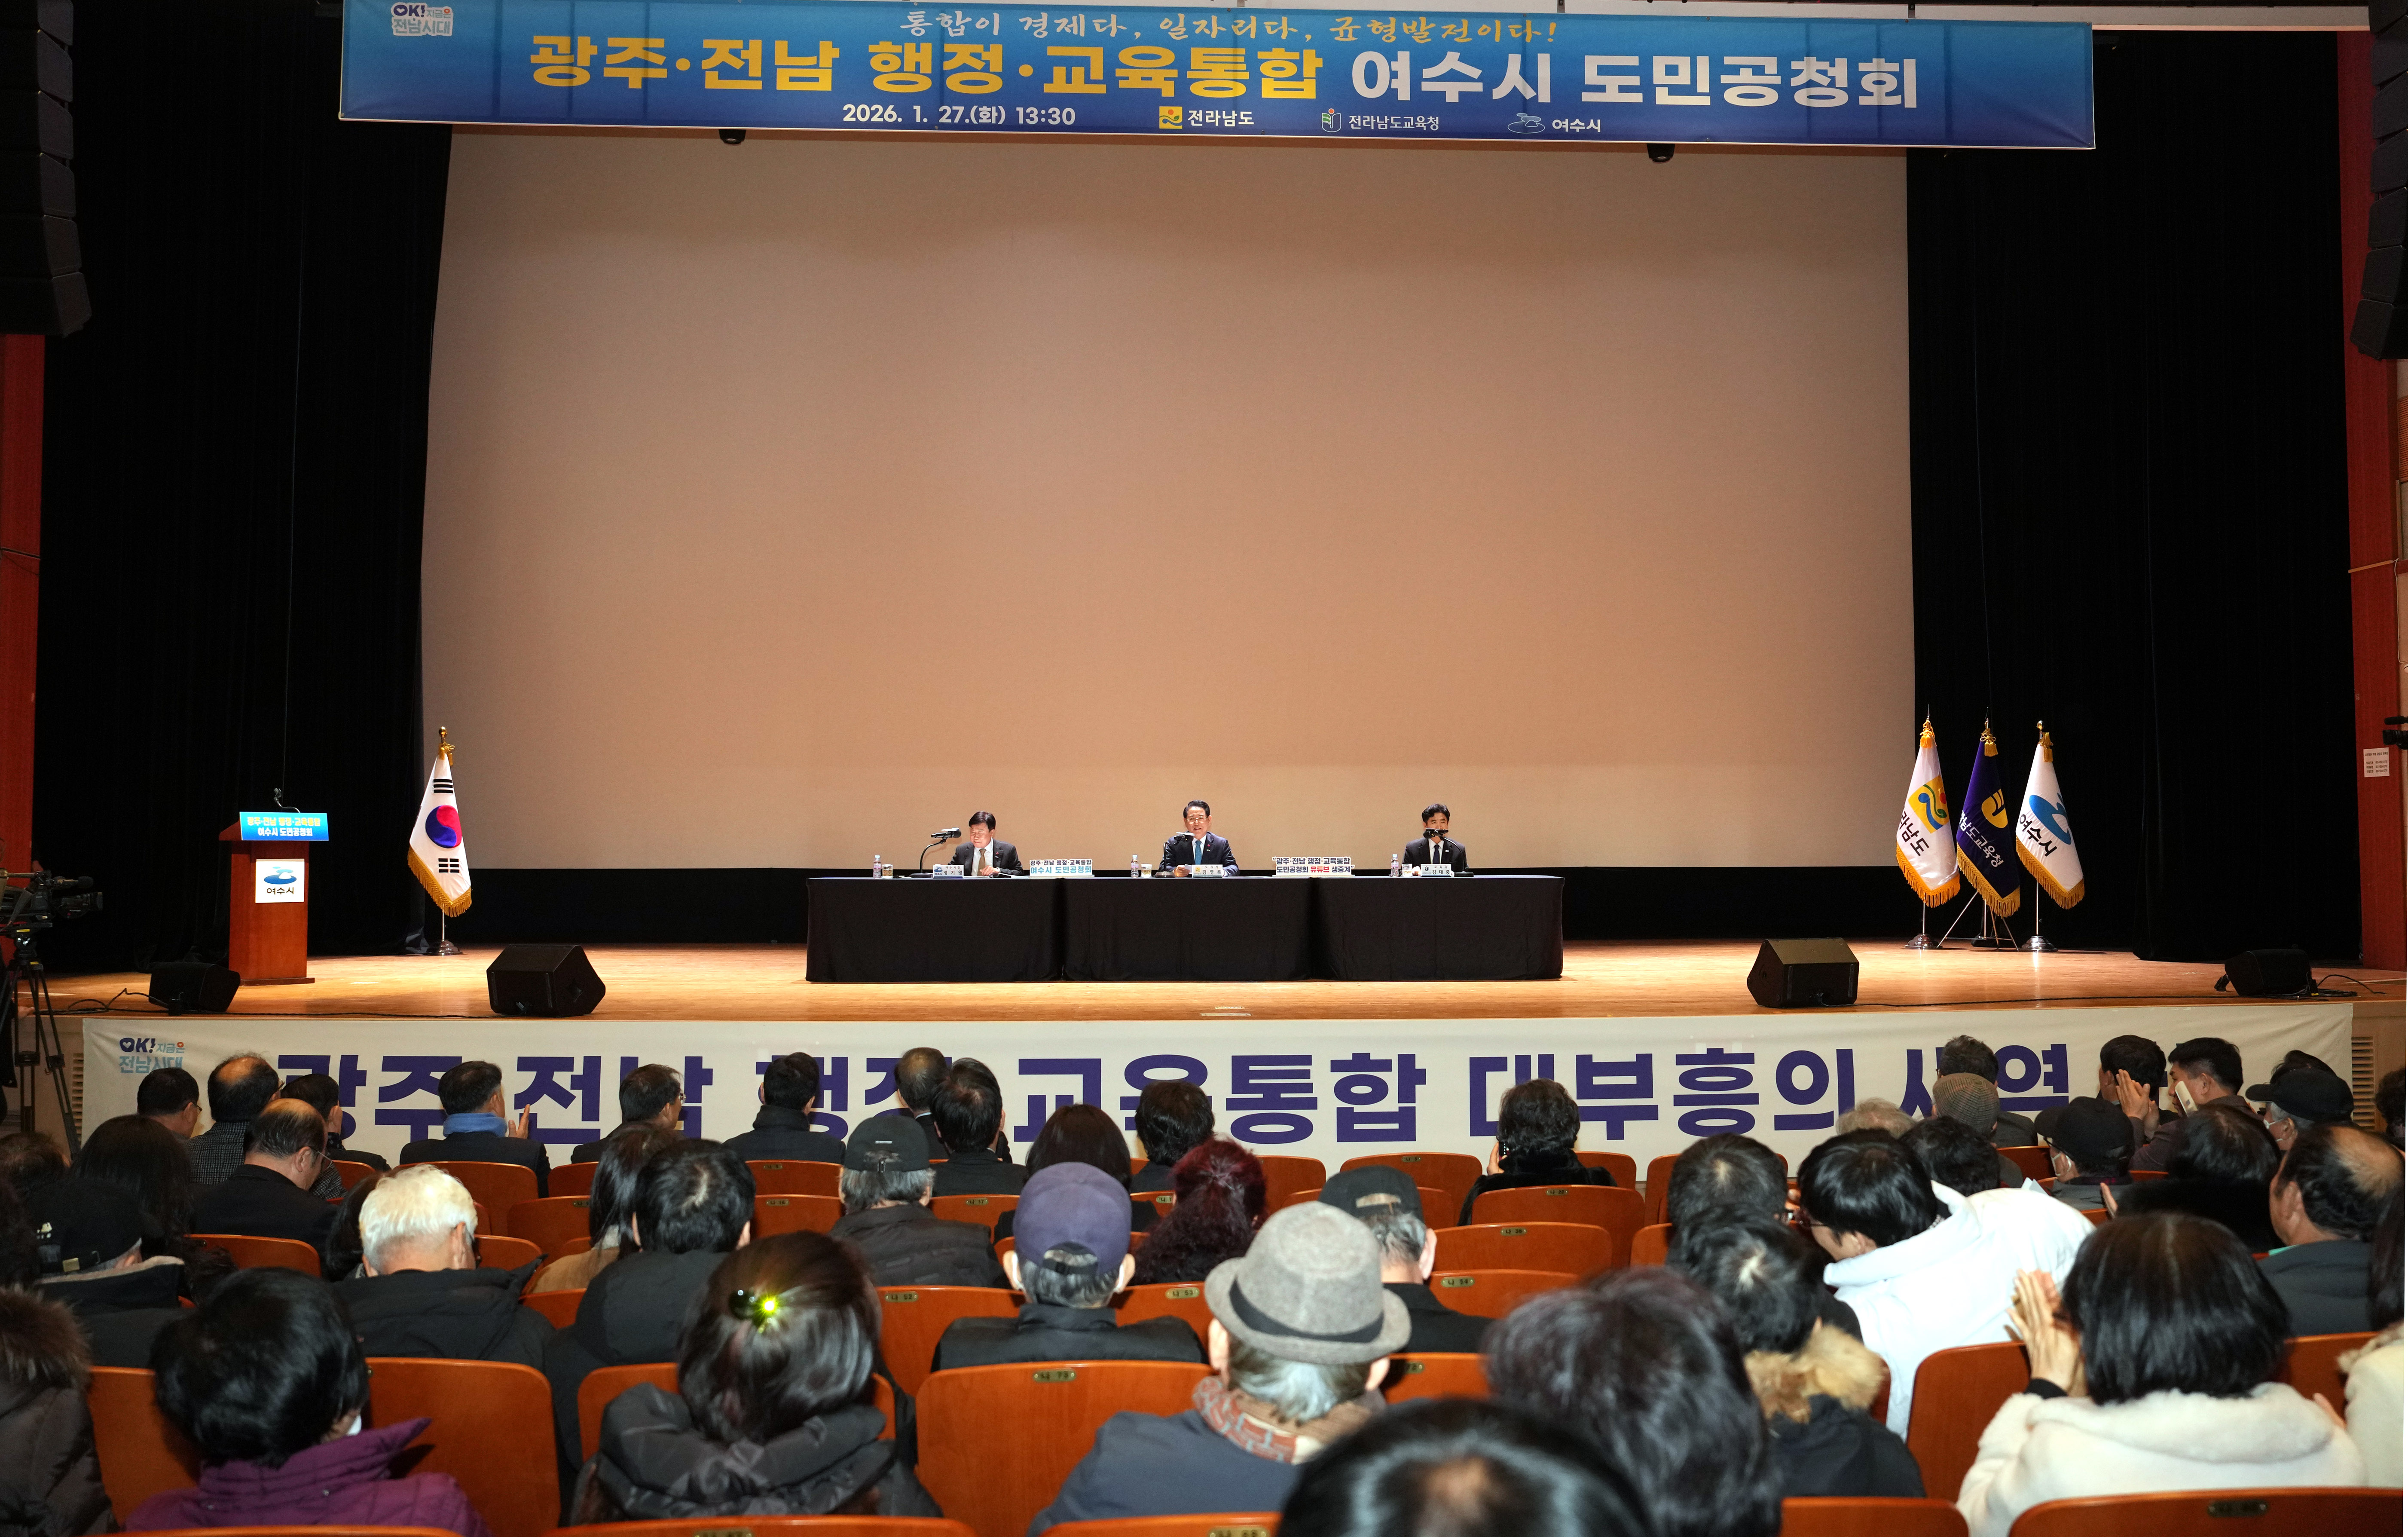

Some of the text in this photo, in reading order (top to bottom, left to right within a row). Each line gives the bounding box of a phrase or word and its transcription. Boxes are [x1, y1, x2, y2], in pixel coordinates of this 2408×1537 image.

[394, 4, 425, 17] OK!
[394, 18, 451, 34] 전남시대
[900, 10, 1556, 43] 통합이 경제다, 일자리다, 균형발전이다!
[530, 35, 1917, 108] 광주·전남 행정·교육통합 여수시 도민공청회
[843, 104, 1075, 125] 2026. 1. 27.(화) 13:30
[1188, 110, 1255, 127] 전라남도
[1348, 114, 1439, 132] 전라남도교육청
[1552, 119, 1601, 133] 여수시
[258, 827, 313, 836] 여수시 도민공청회
[1959, 810, 2004, 868] 남도교육청
[2019, 814, 2057, 857] 여수시
[120, 1038, 185, 1053] OK! 지금은
